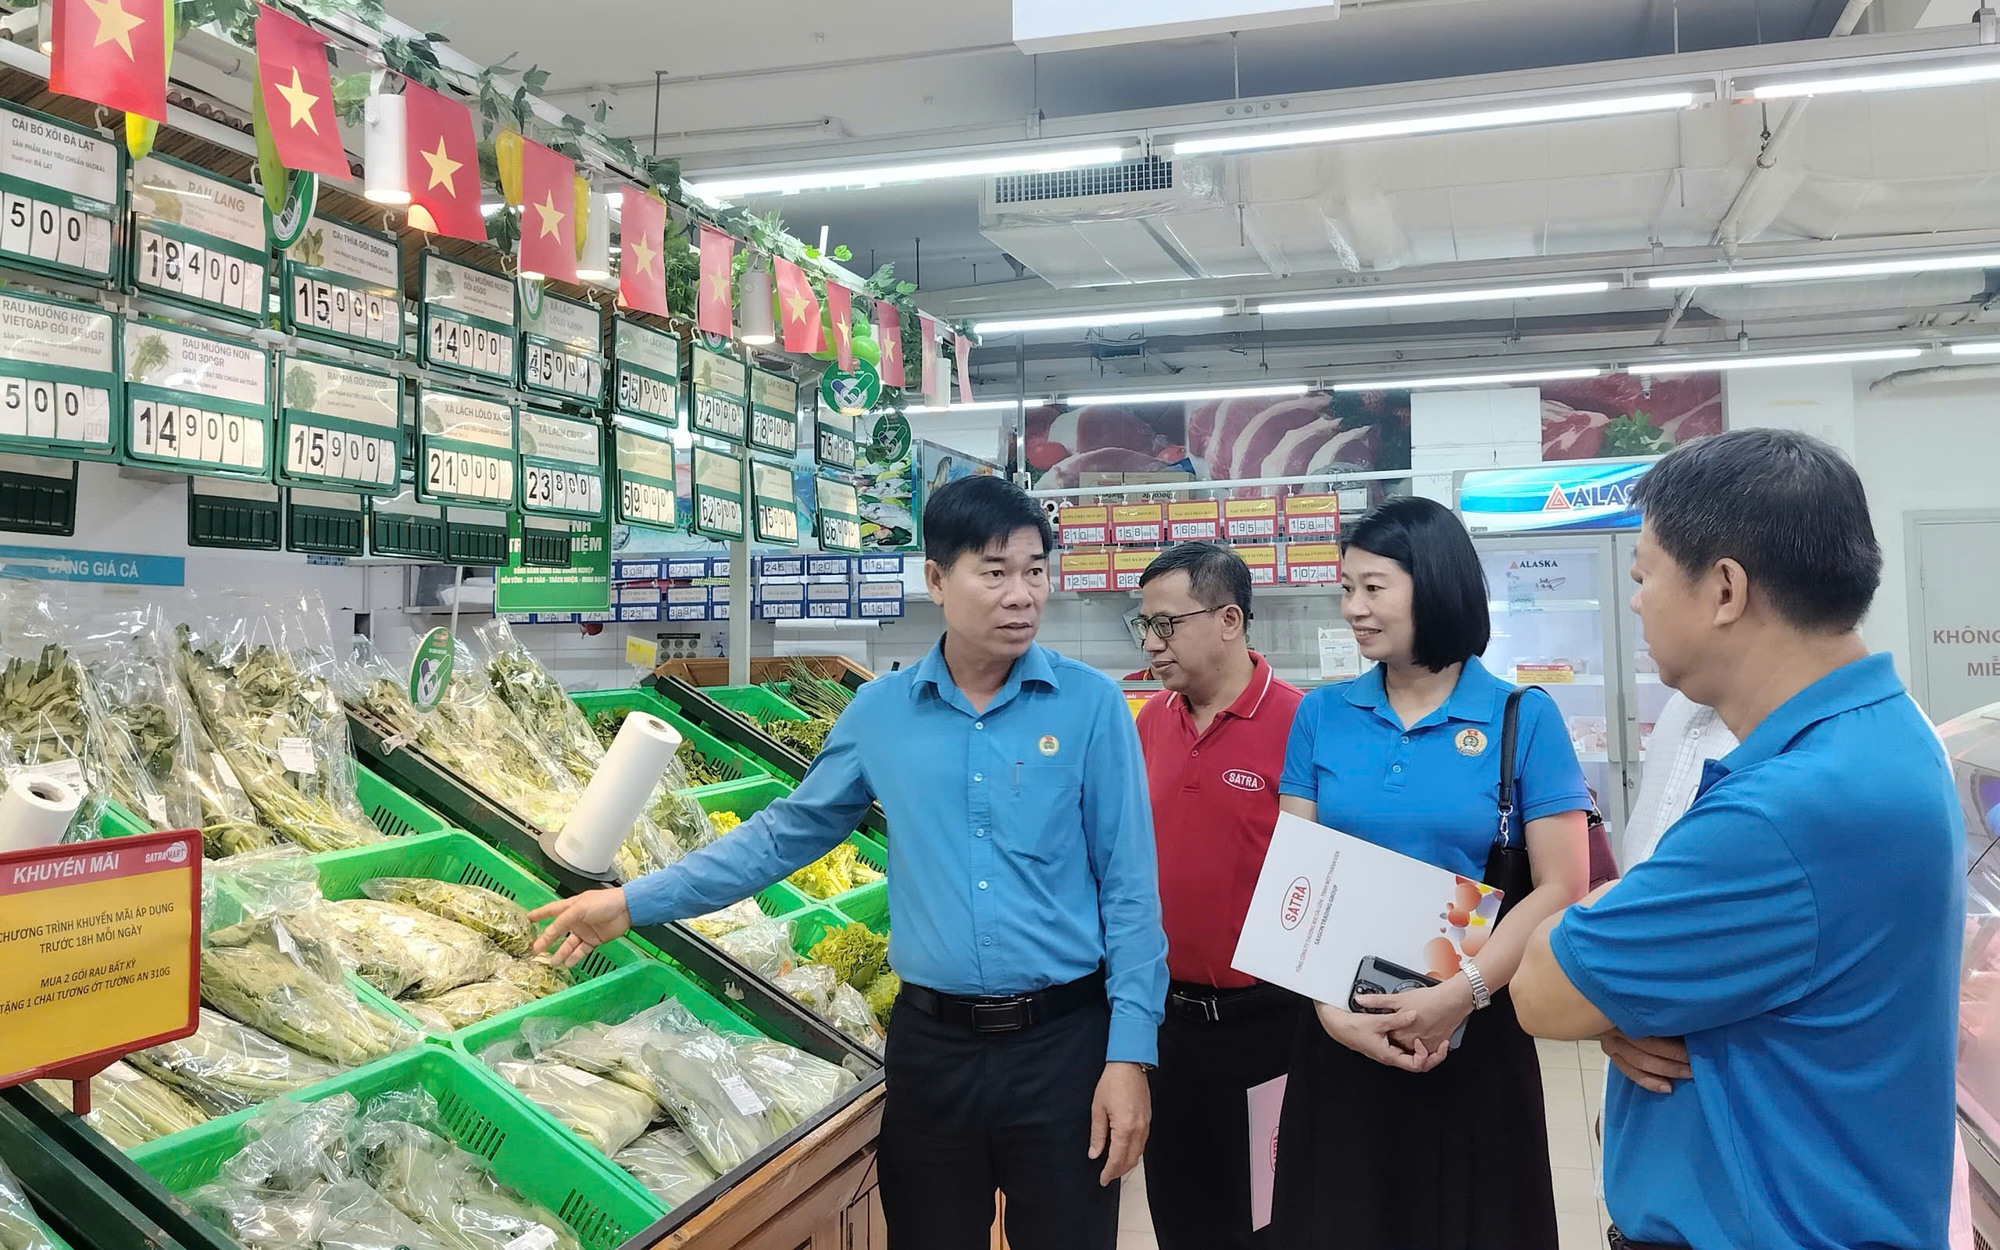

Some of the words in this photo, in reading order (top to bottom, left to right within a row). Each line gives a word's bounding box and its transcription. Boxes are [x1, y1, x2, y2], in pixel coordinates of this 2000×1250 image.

[63, 133, 77, 147] ĐÀ
[78, 139, 95, 152] LẠT
[214, 190, 245, 212] LANG
[10, 202, 81, 242] 500
[2, 300, 25, 313] RAU
[28, 304, 68, 322] MUỐNG
[2, 314, 48, 331] VIETGAP
[50, 322, 68, 335] GÓI
[183, 338, 199, 349] RAU
[233, 349, 250, 360] NON
[5, 383, 79, 417] 500
[1572, 484, 1634, 507] ALAS
[93, 559, 116, 577] GIÁ
[120, 560, 139, 578] CÁ
[1519, 560, 1558, 569] ALASKA
[1933, 625, 2000, 644] KHÔNG
[1229, 772, 1257, 788] SATRA
[90, 851, 119, 873] MÃI
[1285, 885, 1307, 922] SATRA
[45, 920, 74, 935] TRÌNH
[76, 910, 113, 930] KHUYẾN
[115, 908, 133, 922] MÃI
[135, 906, 147, 918] ÁP
[149, 902, 174, 917] DỤNG
[40, 937, 74, 954] TRƯỚC
[76, 934, 94, 947] 18H
[96, 926, 115, 943] MỖI
[117, 924, 142, 939] NGÀY
[40, 976, 62, 988] MUA
[64, 974, 70, 983] 2
[71, 968, 87, 981] GÓI
[89, 965, 107, 978] RAU
[108, 959, 125, 974] BẤT
[0, 1000, 24, 1015] TẶNG
[26, 998, 31, 1008] 1
[34, 993, 55, 1006] CHAI
[57, 984, 89, 1000] TƯƠNG
[91, 981, 104, 993] ỚT
[137, 971, 148, 982] AN
[151, 966, 170, 979] 310G
